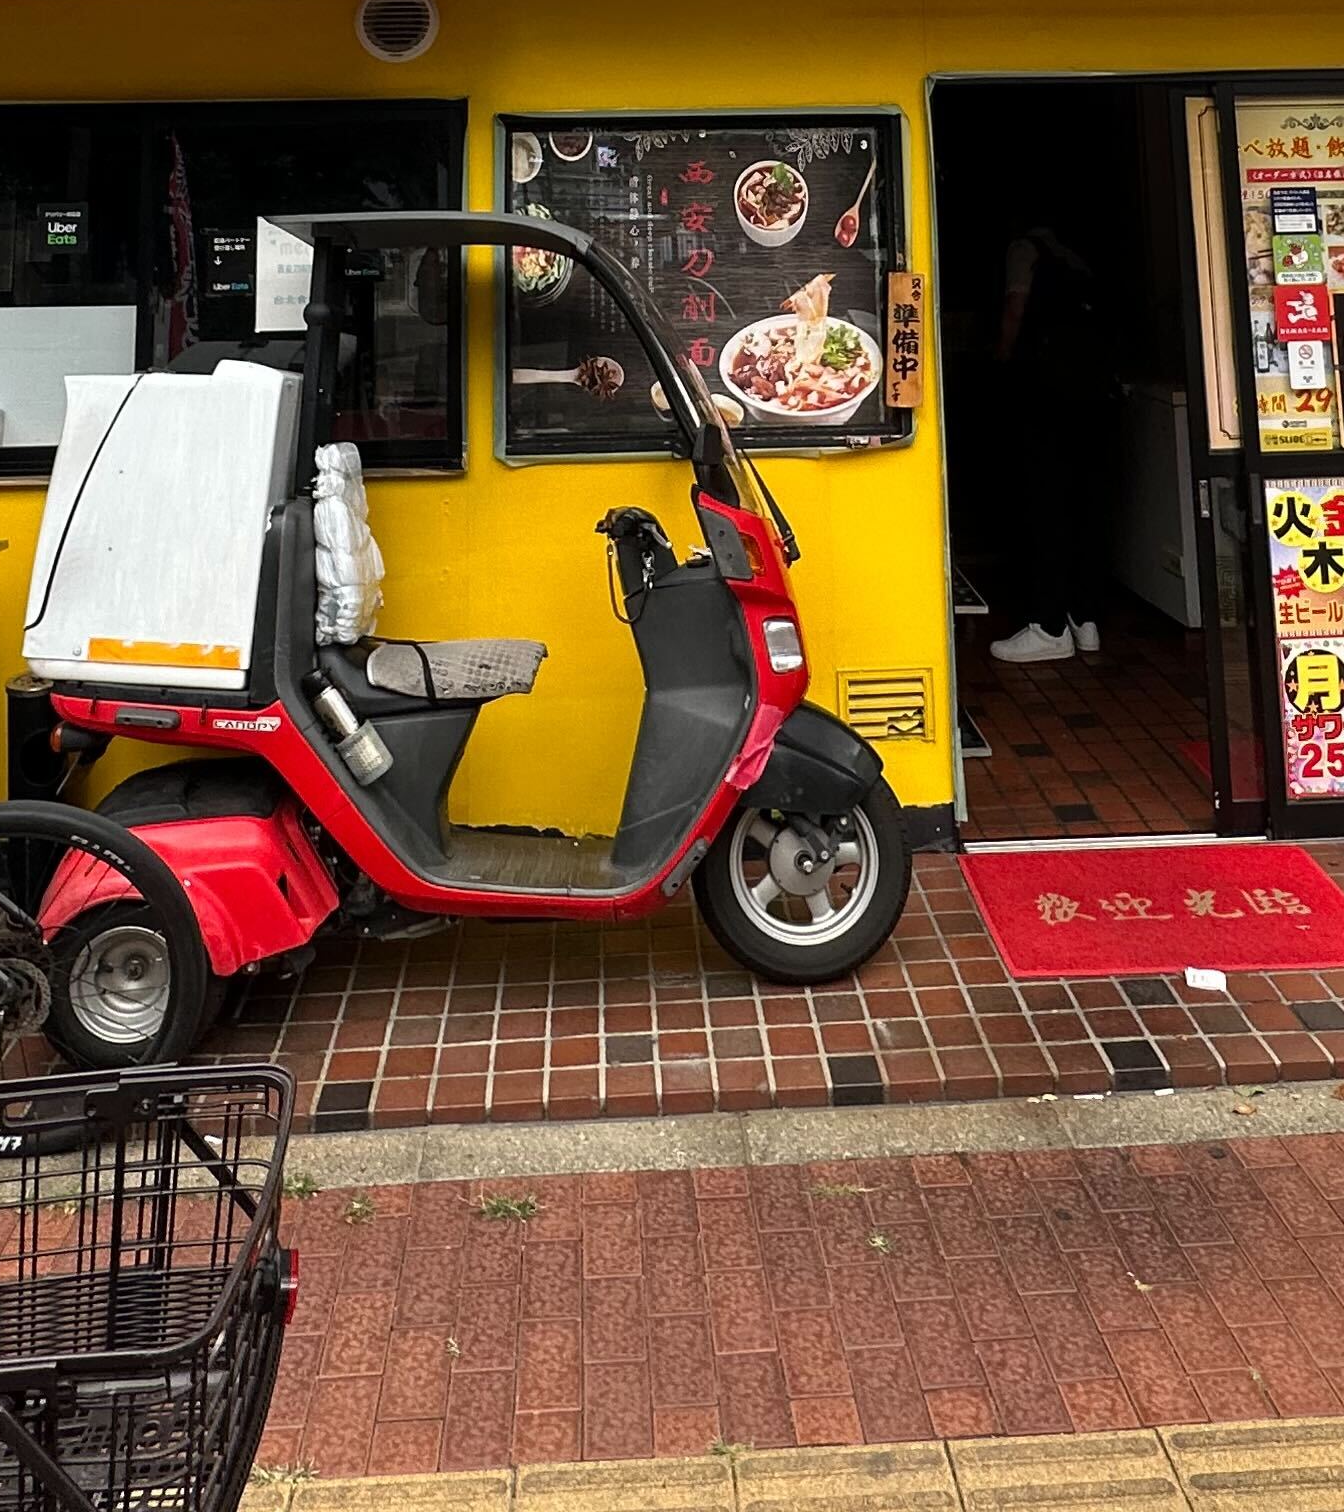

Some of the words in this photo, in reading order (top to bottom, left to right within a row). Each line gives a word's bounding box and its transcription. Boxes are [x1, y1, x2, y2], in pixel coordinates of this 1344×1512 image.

[48, 222, 77, 233] Uber
[48, 234, 77, 245] Eats
[891, 303, 921, 381] 準備中
[213, 720, 280, 731] CANOPY
